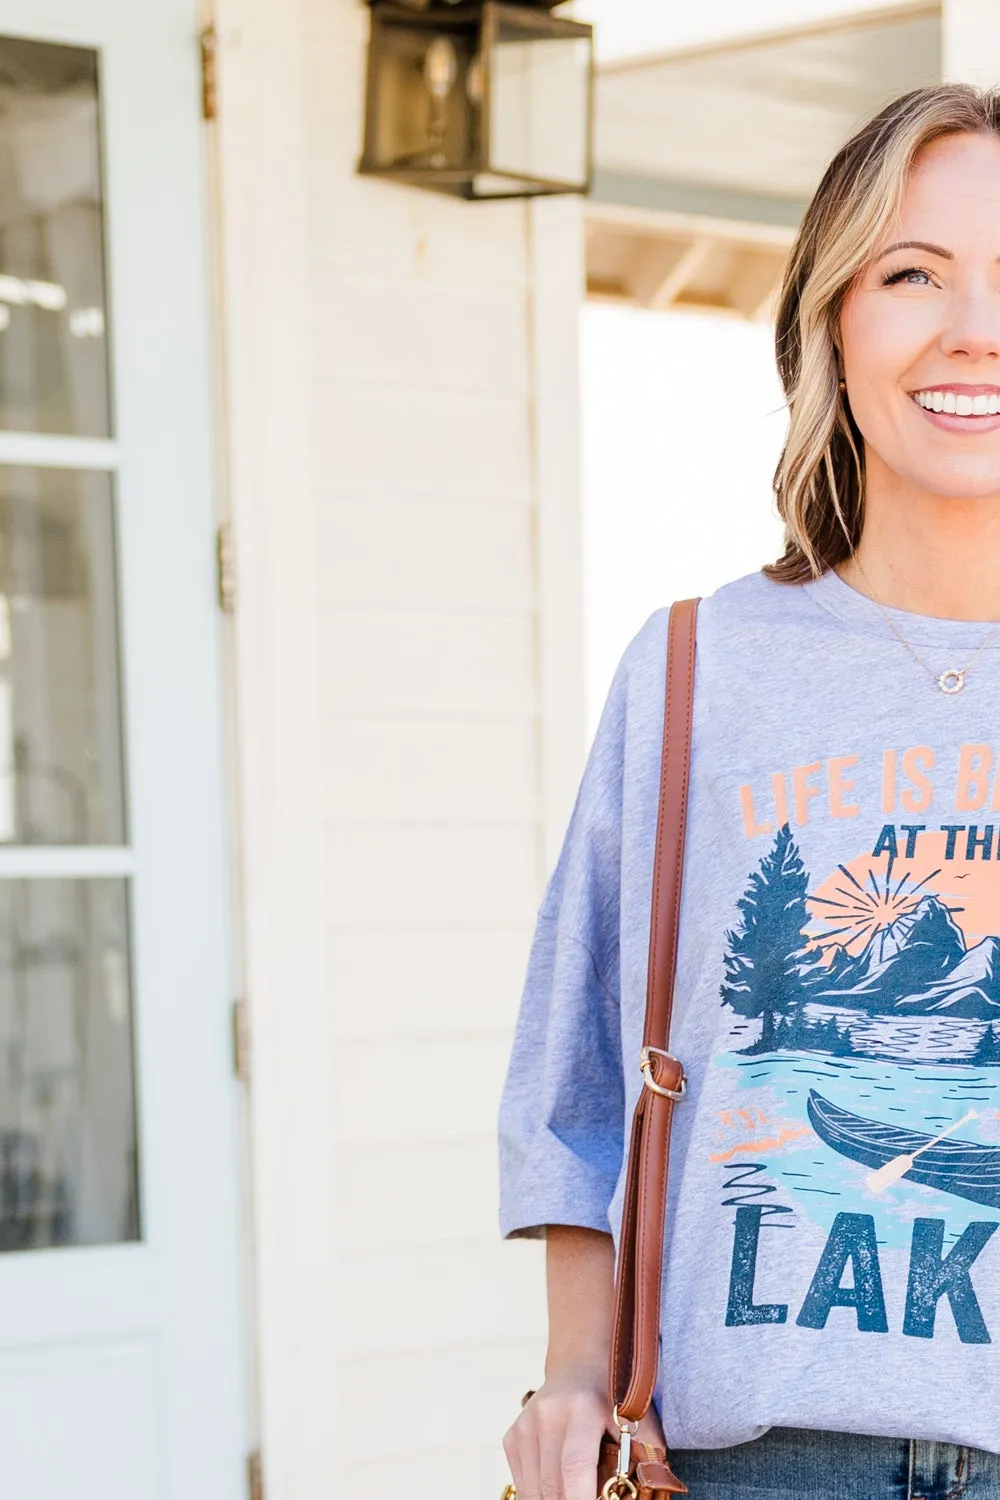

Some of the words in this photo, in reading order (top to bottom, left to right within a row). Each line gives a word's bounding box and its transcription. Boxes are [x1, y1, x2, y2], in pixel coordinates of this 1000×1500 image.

[740, 755, 858, 838] LIFE
[883, 745, 936, 814] IS
[872, 825, 926, 860] AT
